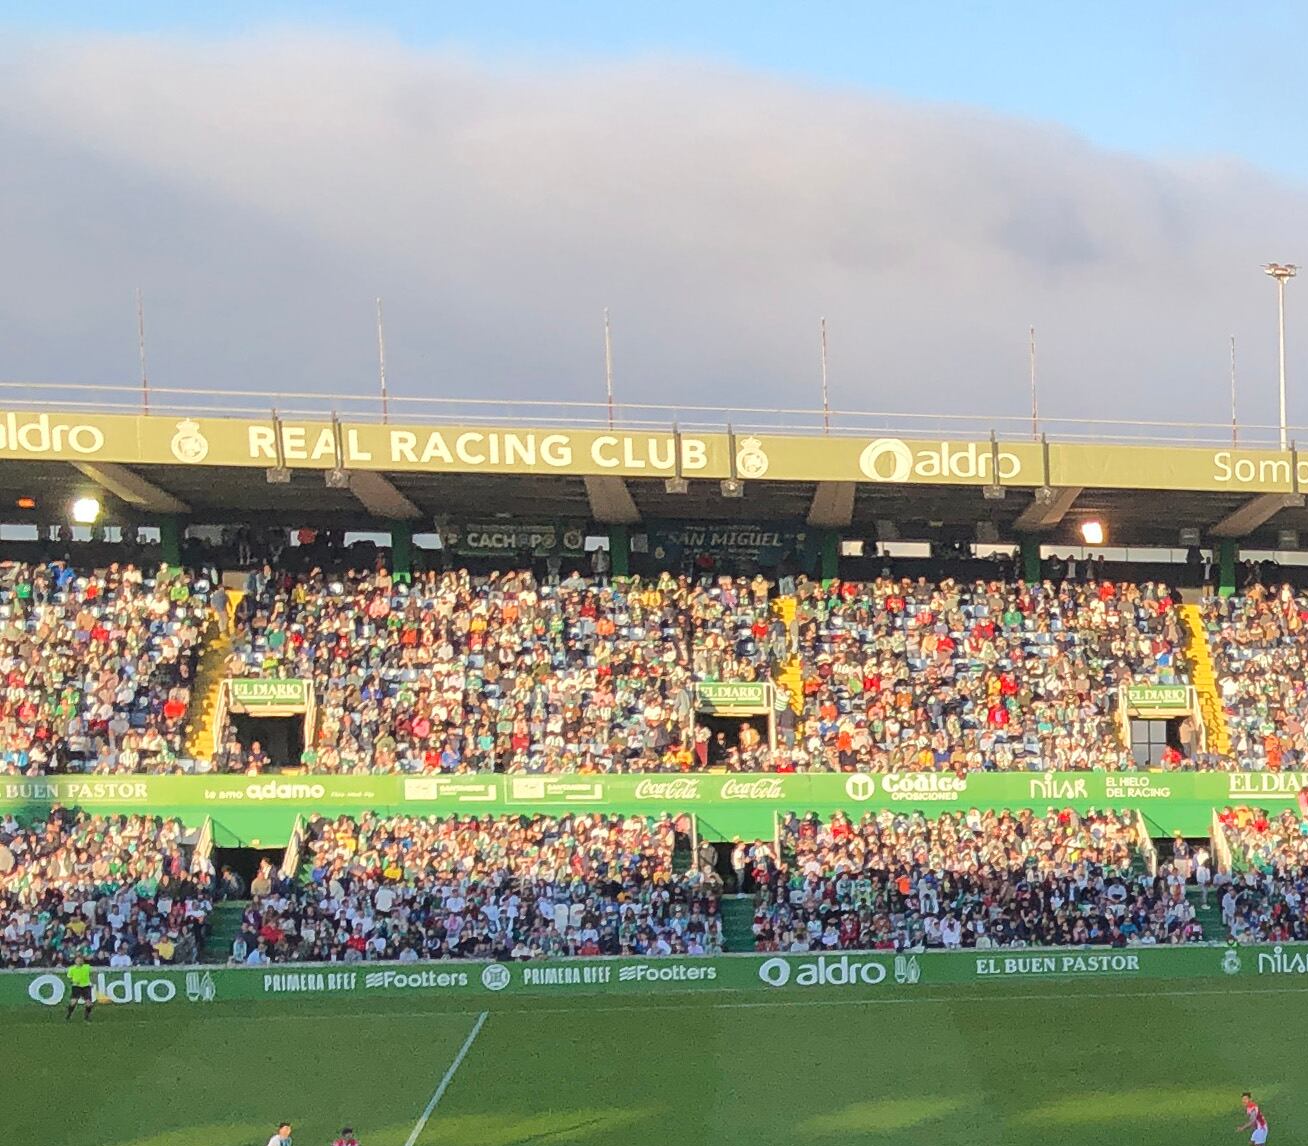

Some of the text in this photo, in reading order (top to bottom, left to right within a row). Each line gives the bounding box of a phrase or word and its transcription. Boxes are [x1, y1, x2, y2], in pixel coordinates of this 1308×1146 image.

[0, 413, 105, 454] ldro
[248, 425, 708, 470] REAL RACING CLUB
[914, 441, 1021, 478] aldro
[710, 532, 784, 547] MIGUEL
[234, 685, 302, 698] EL DIARIO
[719, 687, 762, 698] DIARIO
[1144, 689, 1185, 701] DIARIO
[246, 780, 325, 800] adamo
[1106, 777, 1150, 787] EL HIELO
[1229, 773, 1259, 793] EL
[6, 783, 148, 799] BUEN PASTOR
[891, 792, 958, 801] OPOSICIONES
[1106, 787, 1171, 798] DEL RACING
[796, 956, 887, 986] aldro
[976, 954, 1140, 974] EL BUEN PASTOR
[383, 971, 468, 988] Footters
[523, 967, 581, 985] PRIMERA
[635, 965, 717, 982] Footters
[76, 972, 176, 1004] ldro
[264, 973, 326, 992] PRIMERA
